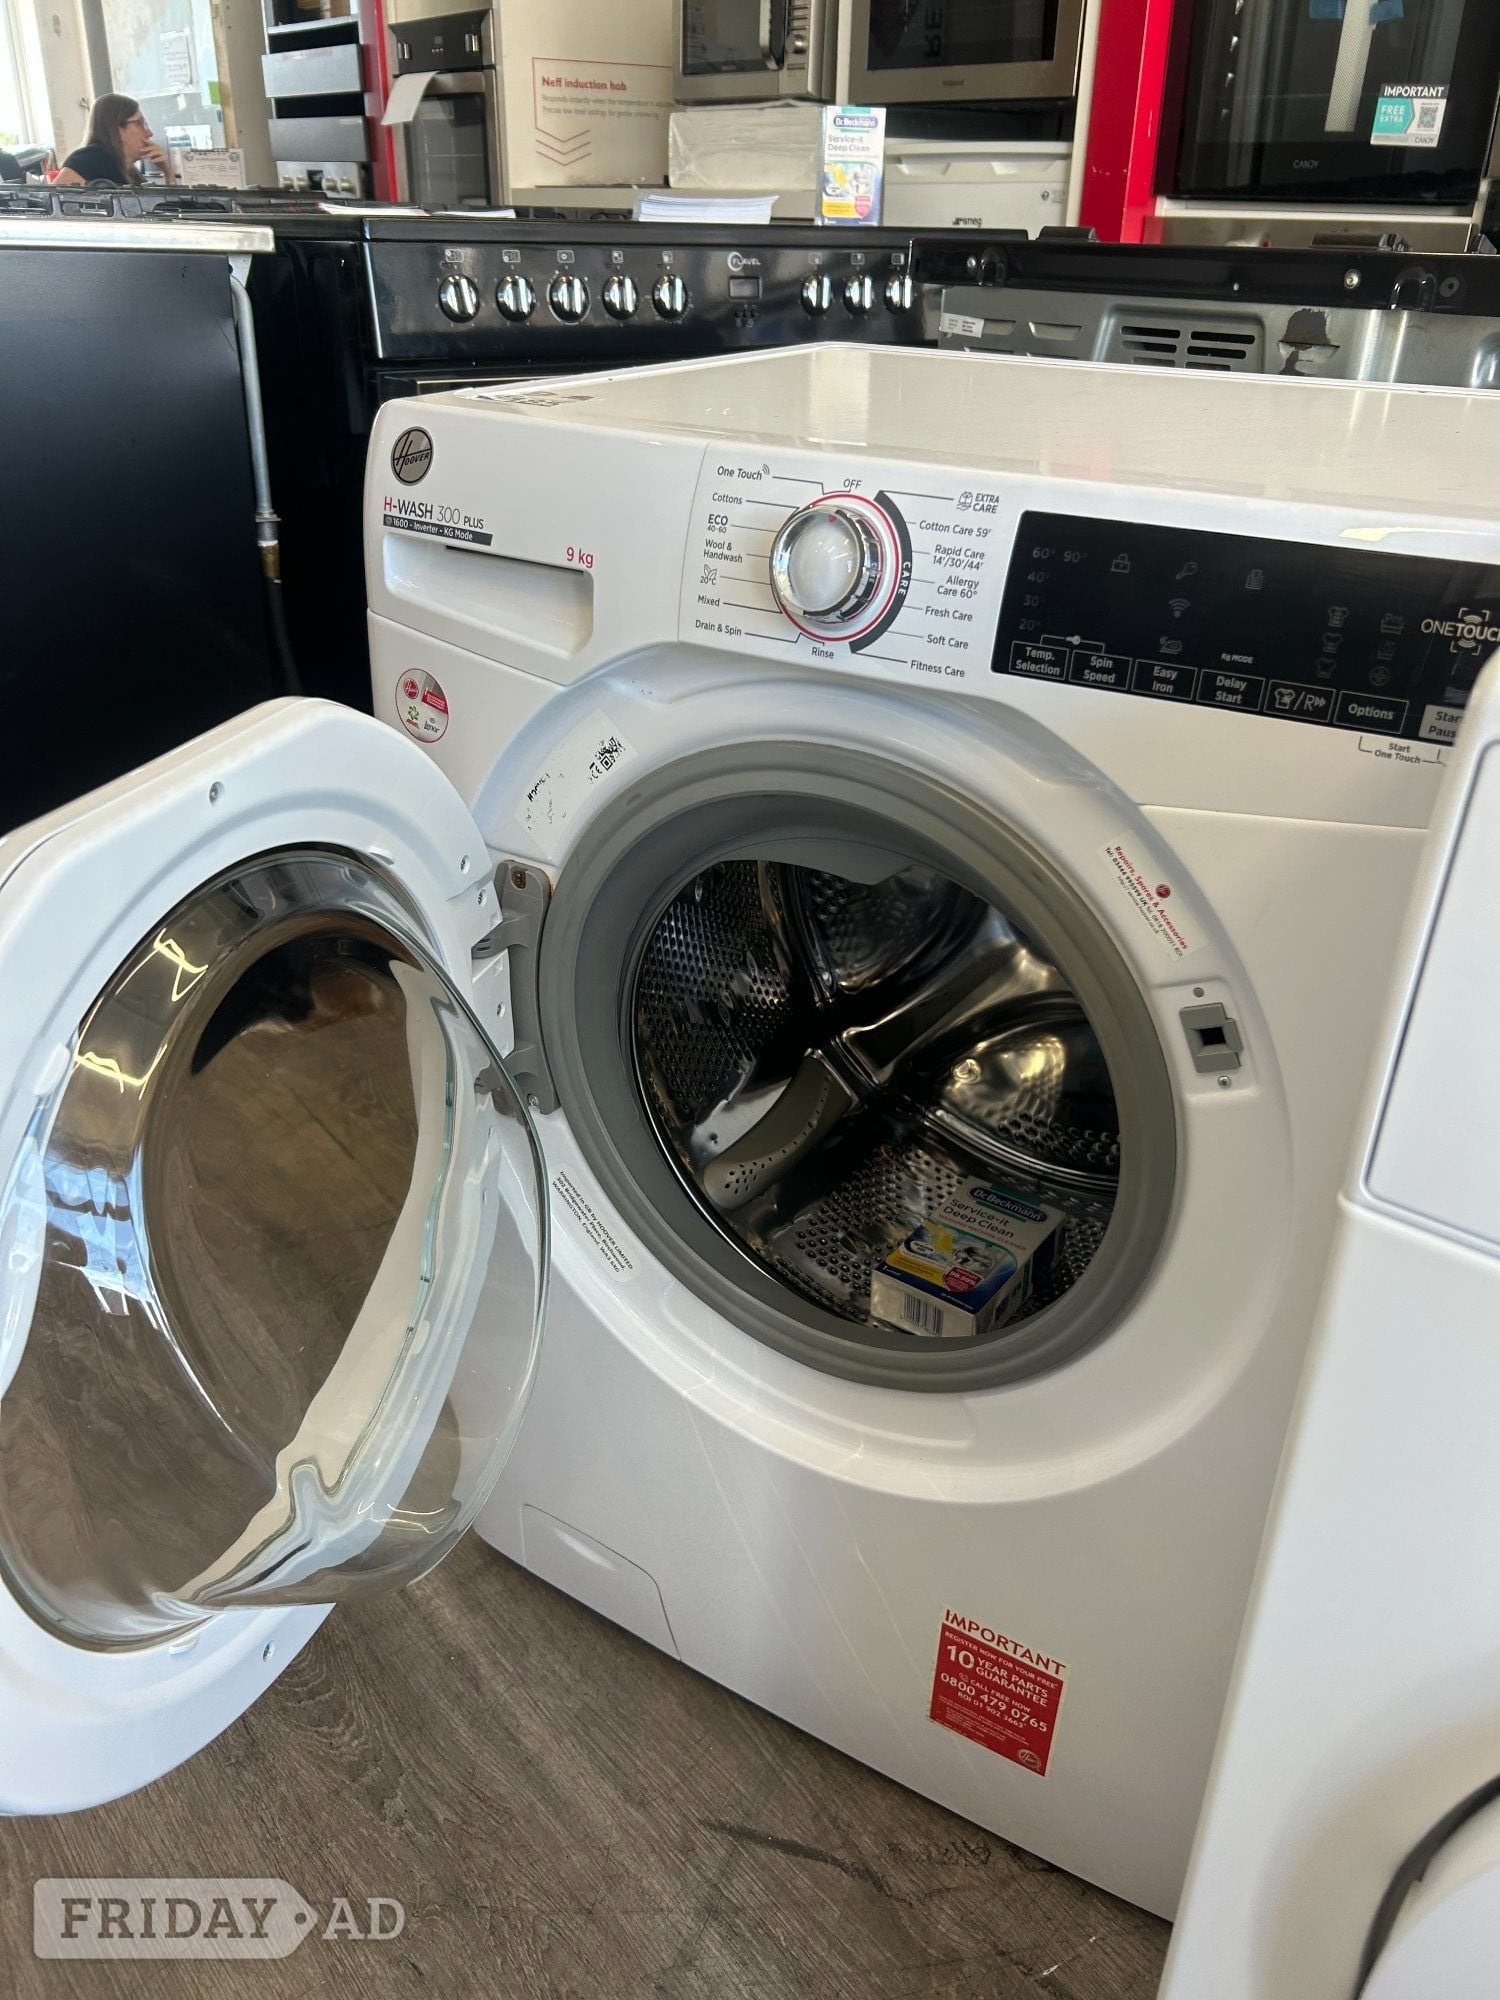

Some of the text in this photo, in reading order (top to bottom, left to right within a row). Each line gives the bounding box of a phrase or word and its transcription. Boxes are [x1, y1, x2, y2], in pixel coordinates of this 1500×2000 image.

[541, 76, 627, 91] Neff induction hob
[1383, 86, 1445, 97] IMPORTANT
[1381, 104, 1406, 115] FREE
[1379, 114, 1404, 123] EXTRA
[828, 134, 863, 143] Service-it
[828, 144, 870, 152] Deep Clean
[1293, 160, 1320, 169] CANDY
[717, 466, 763, 480] One Touch
[843, 478, 862, 489] OFF
[712, 493, 743, 505] Cottons
[975, 493, 1000, 504] EXTRA
[383, 496, 484, 529] H-WASH 300 PLUS
[972, 503, 999, 514] CARE
[708, 514, 728, 526] ECO
[393, 517, 409, 529] 1600
[413, 521, 438, 534] Inverter
[444, 527, 454, 537] KG
[454, 529, 473, 541] Mode
[919, 520, 949, 534] Cotton
[952, 524, 974, 536] Care
[705, 539, 732, 551] Wool &
[934, 544, 985, 560] Rapid Care
[566, 547, 594, 568] 9 kg
[703, 550, 743, 563] Handwash
[898, 560, 912, 596] CARE
[946, 575, 980, 589] Allergy
[937, 585, 958, 597] Care
[697, 595, 720, 607] Mixed
[925, 606, 973, 622] Fresh Care
[695, 620, 742, 637] Drain & Spin
[927, 634, 969, 649] Soft Care
[811, 647, 834, 660] Rinse
[1025, 646, 1055, 661] Temp.
[1232, 655, 1253, 664] MODE
[910, 660, 965, 678] Fitness Care
[1015, 661, 1060, 676] Selection
[1090, 655, 1113, 669] Spin
[1083, 669, 1115, 684] Speed
[1153, 666, 1178, 681] Easy
[1152, 681, 1173, 693] Iron
[1216, 675, 1247, 692] Delay
[1215, 691, 1242, 704] Start
[1348, 704, 1394, 721] Options
[1428, 726, 1457, 738] Paus
[1388, 743, 1411, 753] Start
[1374, 750, 1421, 764] One Touch
[1114, 846, 1135, 876] Repairs,
[1135, 876, 1154, 901] Spares
[1157, 909, 1188, 950] Accessories
[1140, 897, 1148, 906] UK
[564, 1188, 590, 1221] Bridgewater
[560, 1171, 634, 1270] Imported in GB by HOOVER LIMITED
[949, 1199, 1010, 1227] Service-it
[943, 1205, 1014, 1239] Deep Clean
[945, 1608, 1066, 1675] IMPORTANT
[944, 1631, 978, 1651] REGISTER
[979, 1648, 997, 1660] NOW
[998, 1657, 1013, 1669] FOR
[1015, 1666, 1035, 1680] YOUR
[946, 1645, 1049, 1698] 10 YEAR PARTS
[975, 1666, 1048, 1707] GUARANTEE
[940, 1672, 976, 1696] 0800
[979, 1693, 1007, 1710] 479
[1011, 1708, 1048, 1732] 0765
[970, 1679, 1031, 1713] CALL FREE NOW
[957, 1691, 972, 1704] ROI
[973, 1699, 983, 1708] 01
[986, 1704, 1001, 1717] 902
